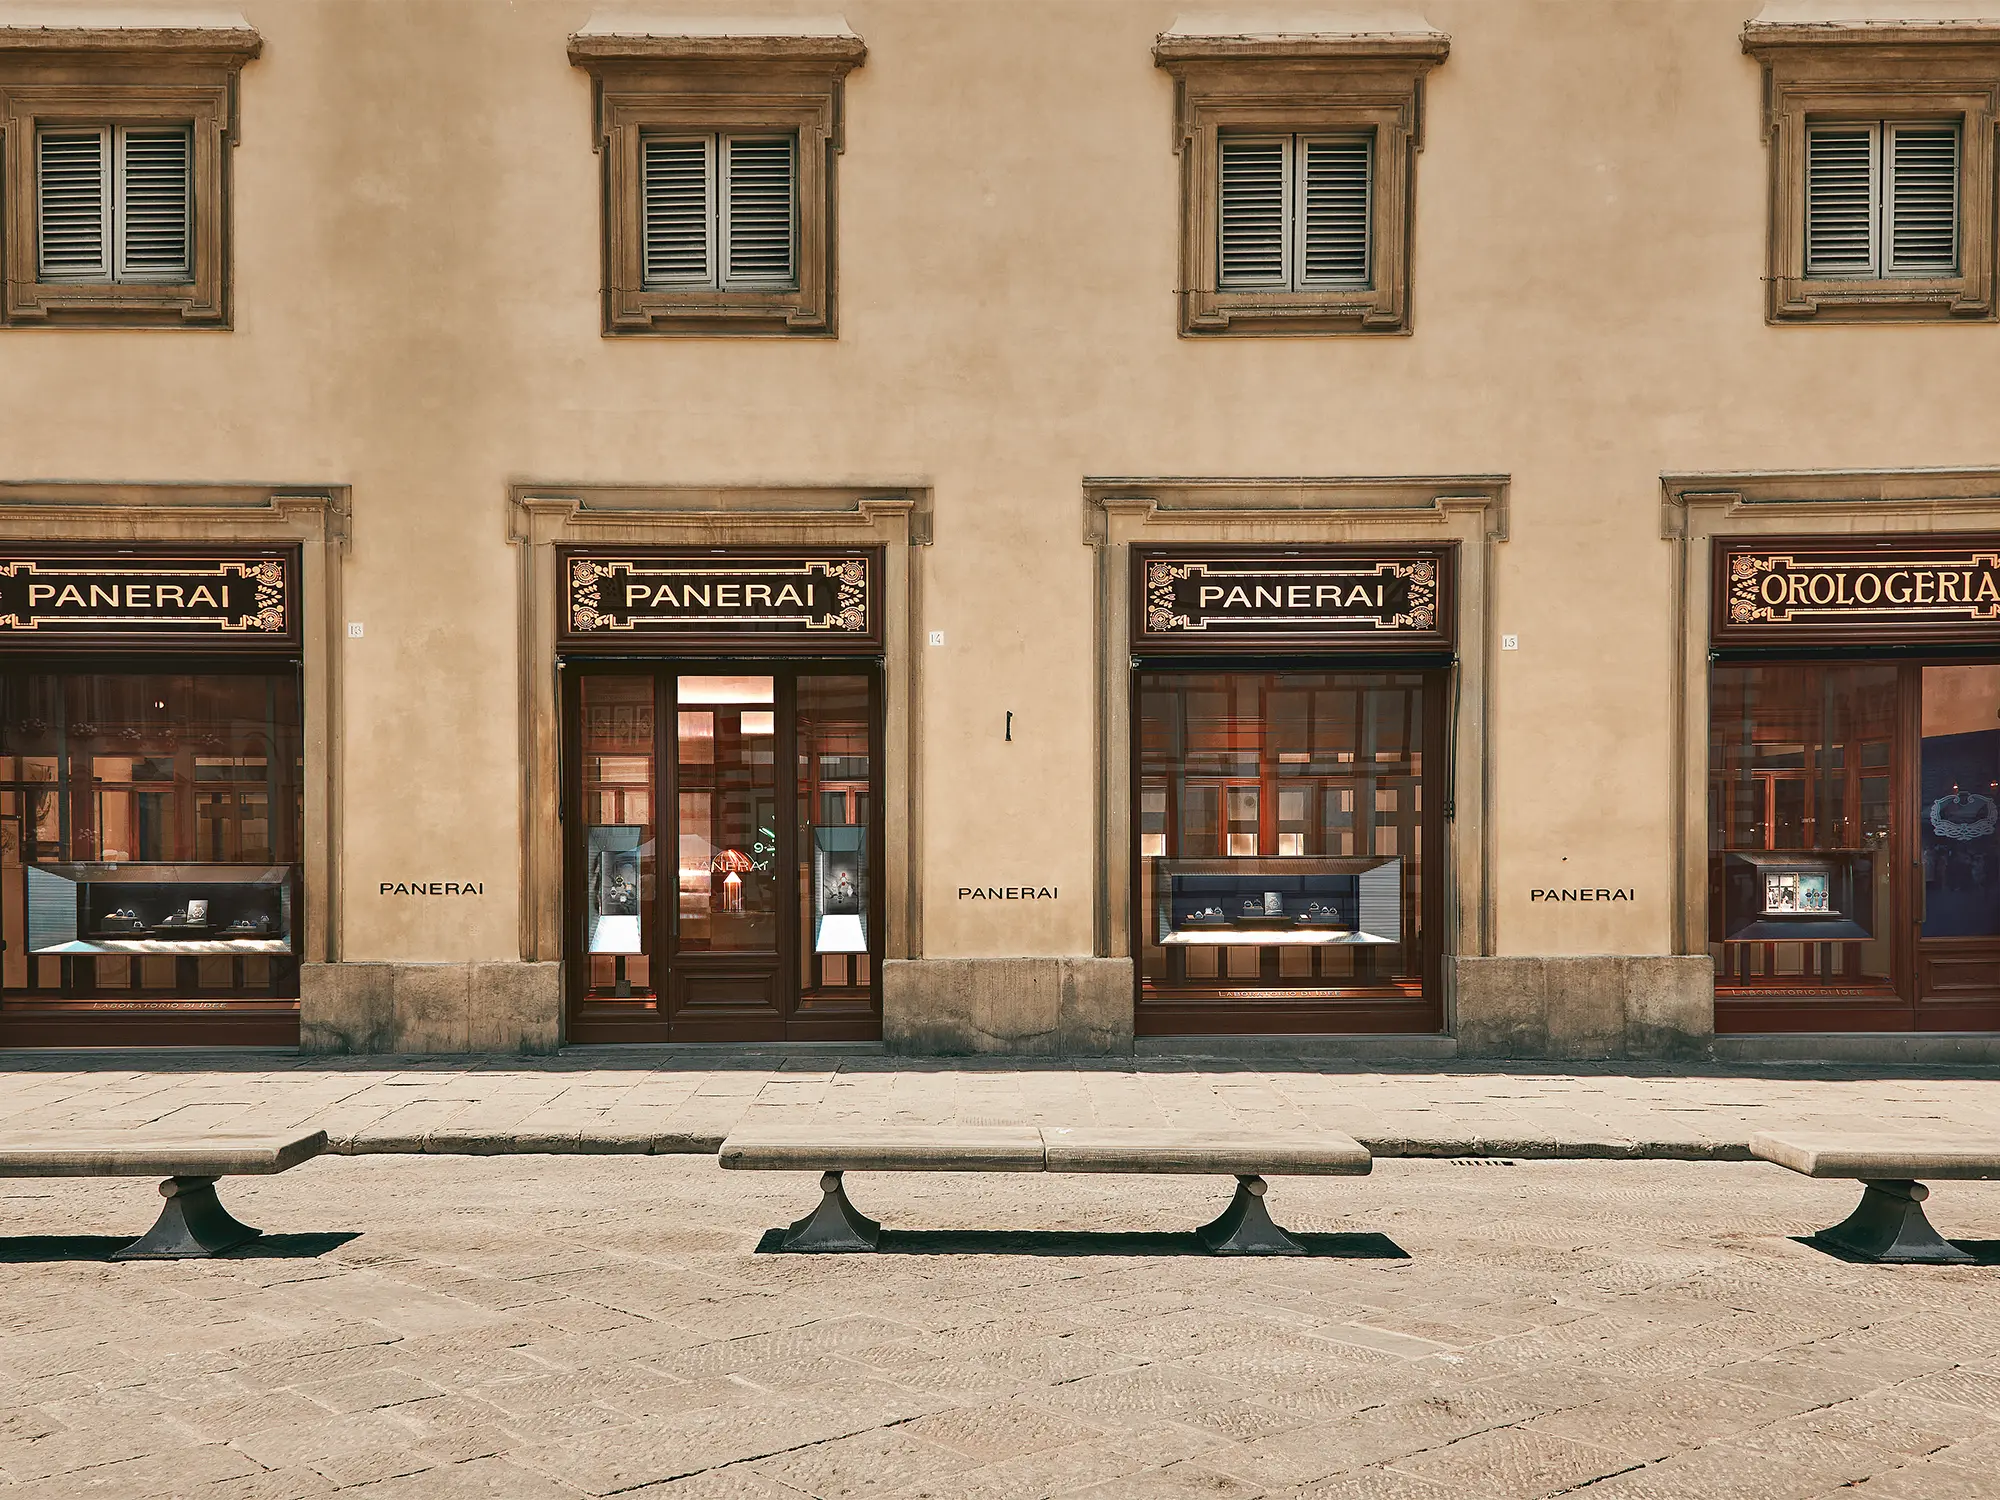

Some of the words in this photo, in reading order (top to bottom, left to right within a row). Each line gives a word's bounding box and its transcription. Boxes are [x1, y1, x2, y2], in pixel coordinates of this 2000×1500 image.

[28, 584, 229, 608] PANERAI
[625, 583, 814, 608] PANERAI
[1199, 584, 1383, 608] PANERAI
[1761, 570, 2000, 605] OROLOGERIA
[379, 882, 484, 896] PANERAI
[958, 887, 1059, 900] PANERAI
[1530, 888, 1635, 902] PANERAI
